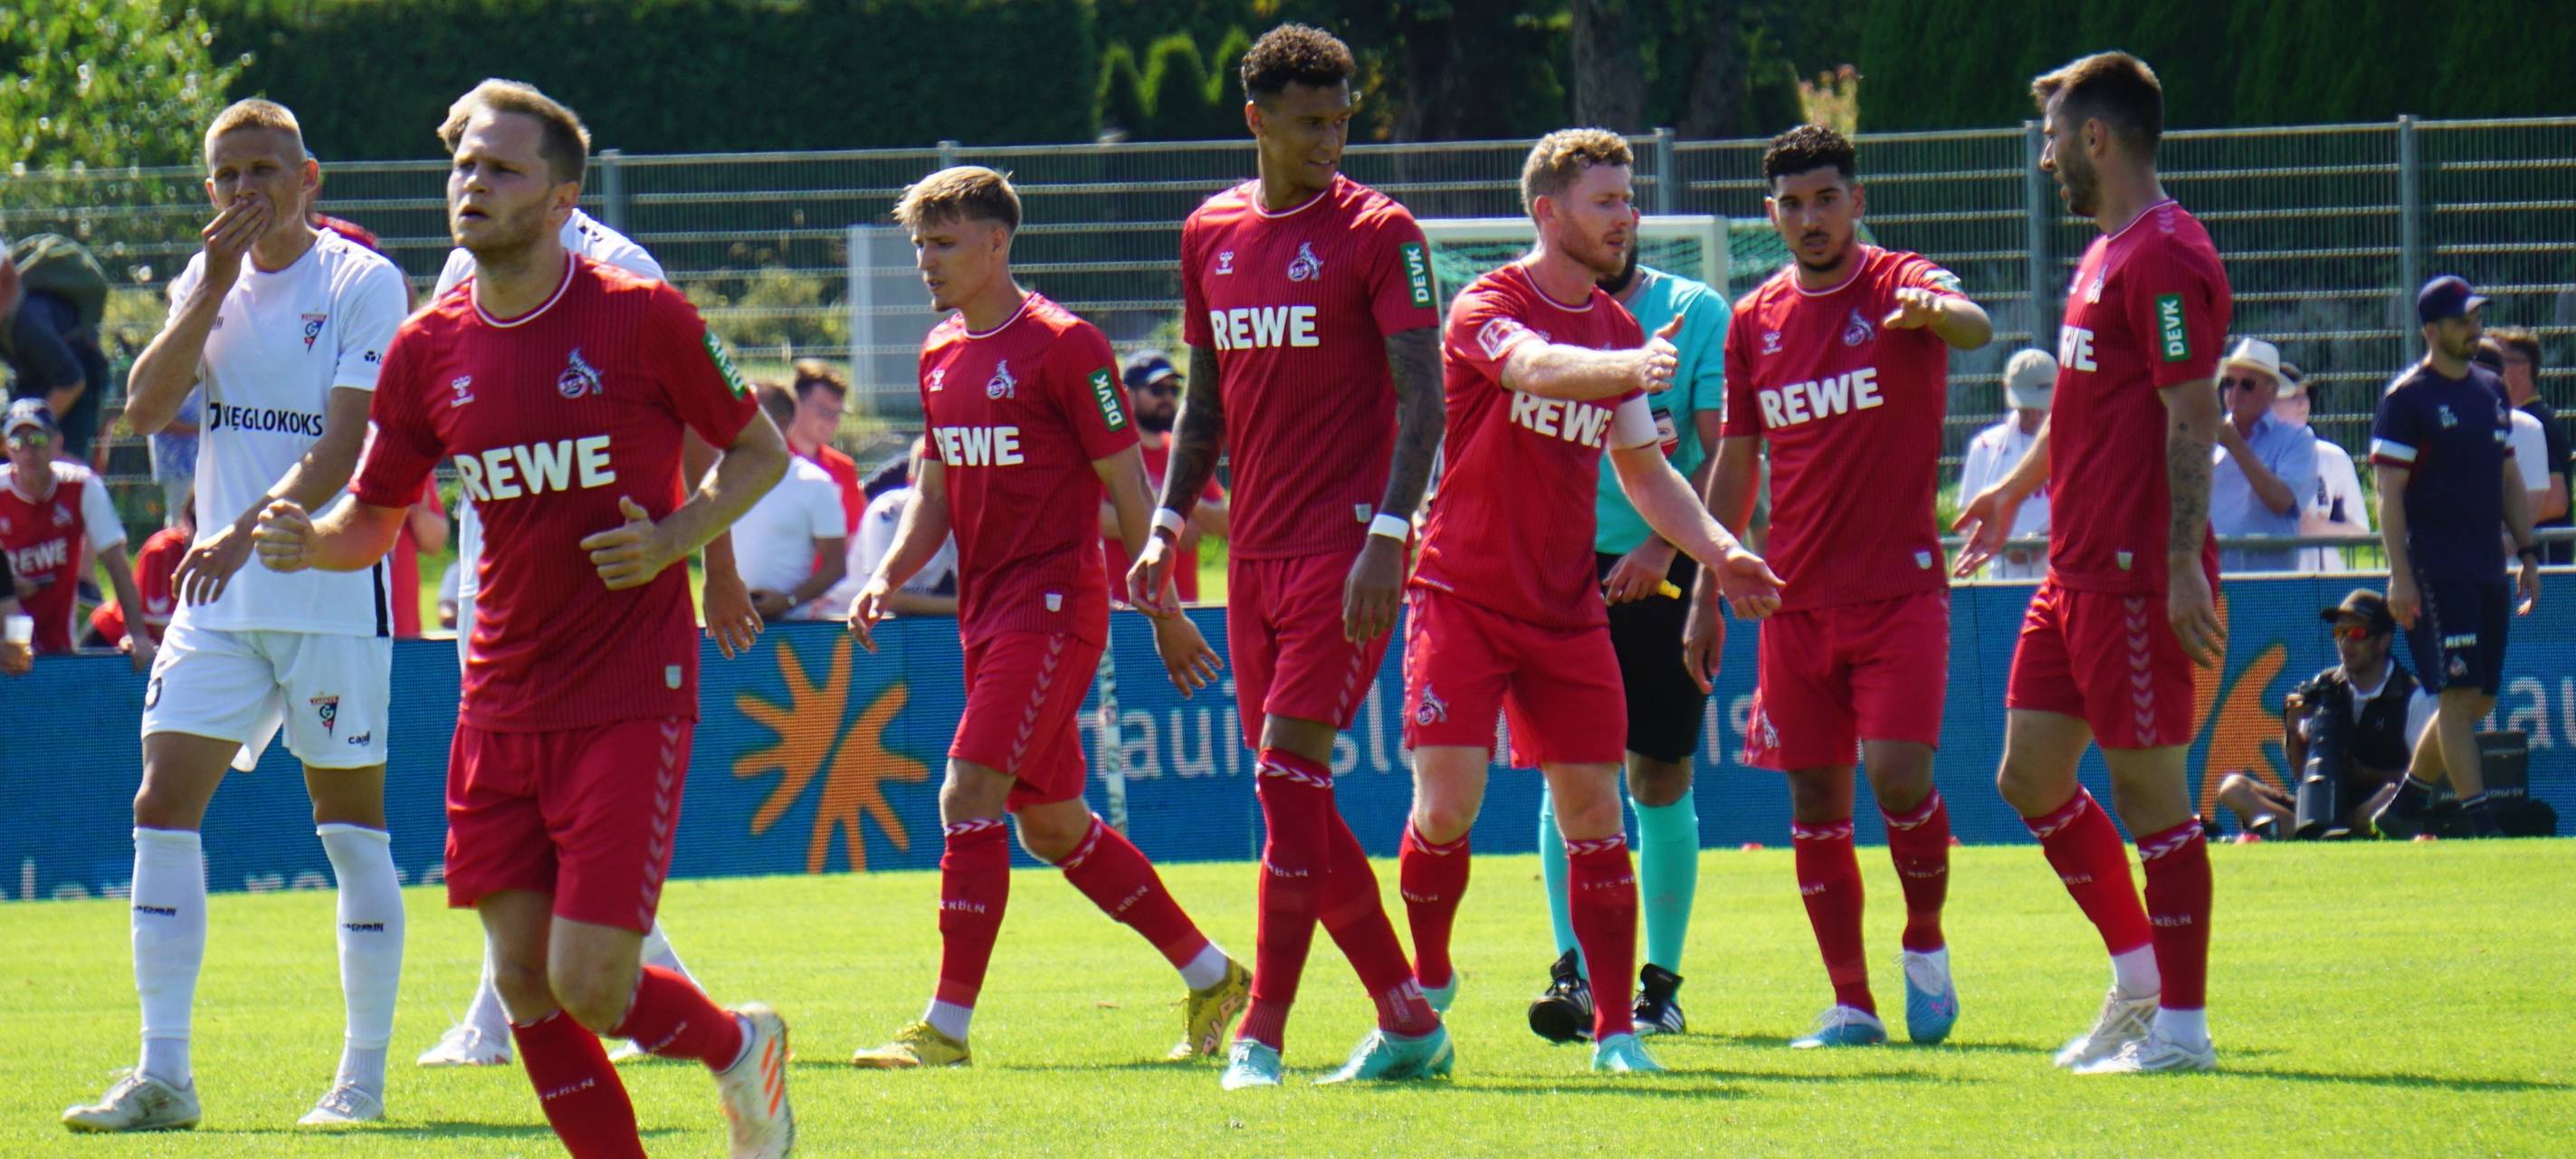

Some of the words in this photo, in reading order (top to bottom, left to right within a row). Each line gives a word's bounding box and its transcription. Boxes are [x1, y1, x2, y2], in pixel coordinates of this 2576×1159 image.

[1407, 247, 1430, 302] DEVK
[1210, 306, 1320, 350] REWE
[2162, 300, 2185, 357] DEVK
[1094, 374, 1123, 426] DEVK
[1511, 391, 1614, 448] REWE
[1759, 367, 1884, 429] REWE
[453, 435, 616, 502] REWE
